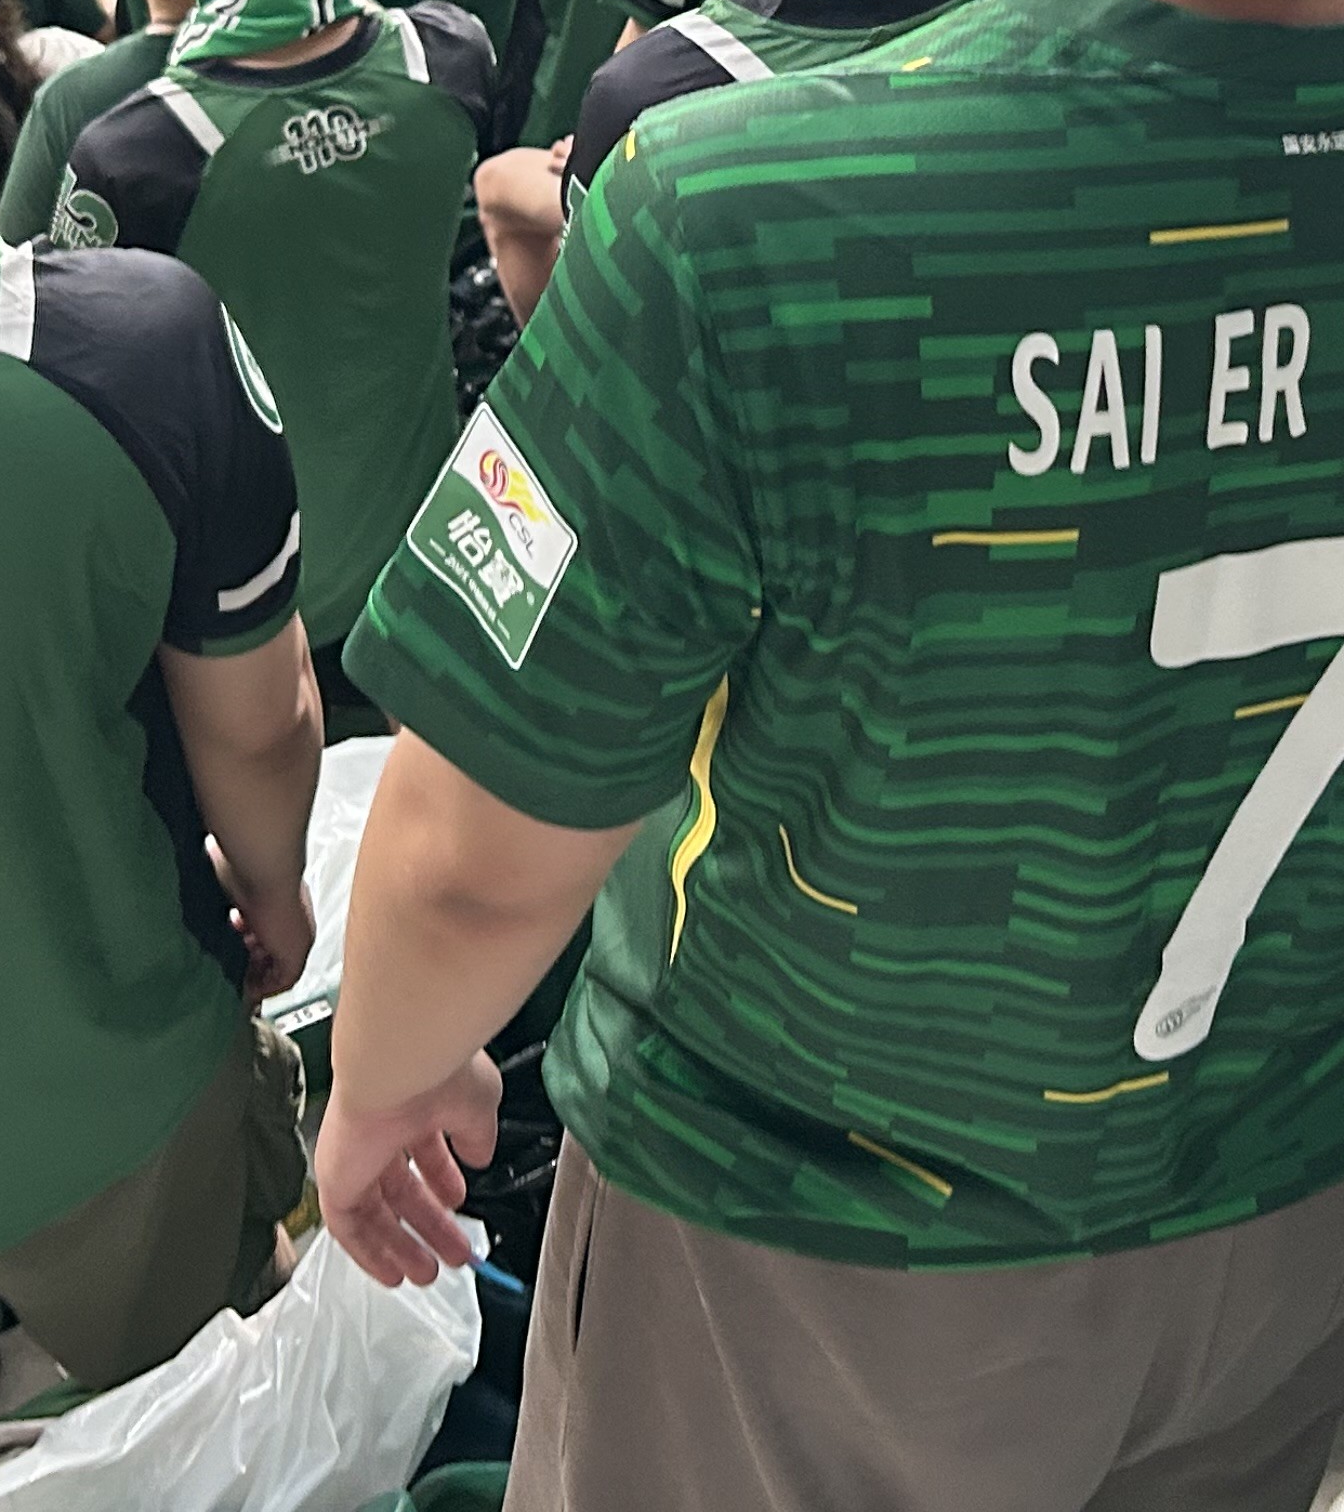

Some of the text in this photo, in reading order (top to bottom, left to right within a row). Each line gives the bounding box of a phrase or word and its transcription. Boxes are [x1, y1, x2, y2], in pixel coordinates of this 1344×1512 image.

[1007, 323, 1163, 476] SAI
[1207, 301, 1311, 450] ER
[509, 512, 535, 559] CSL
